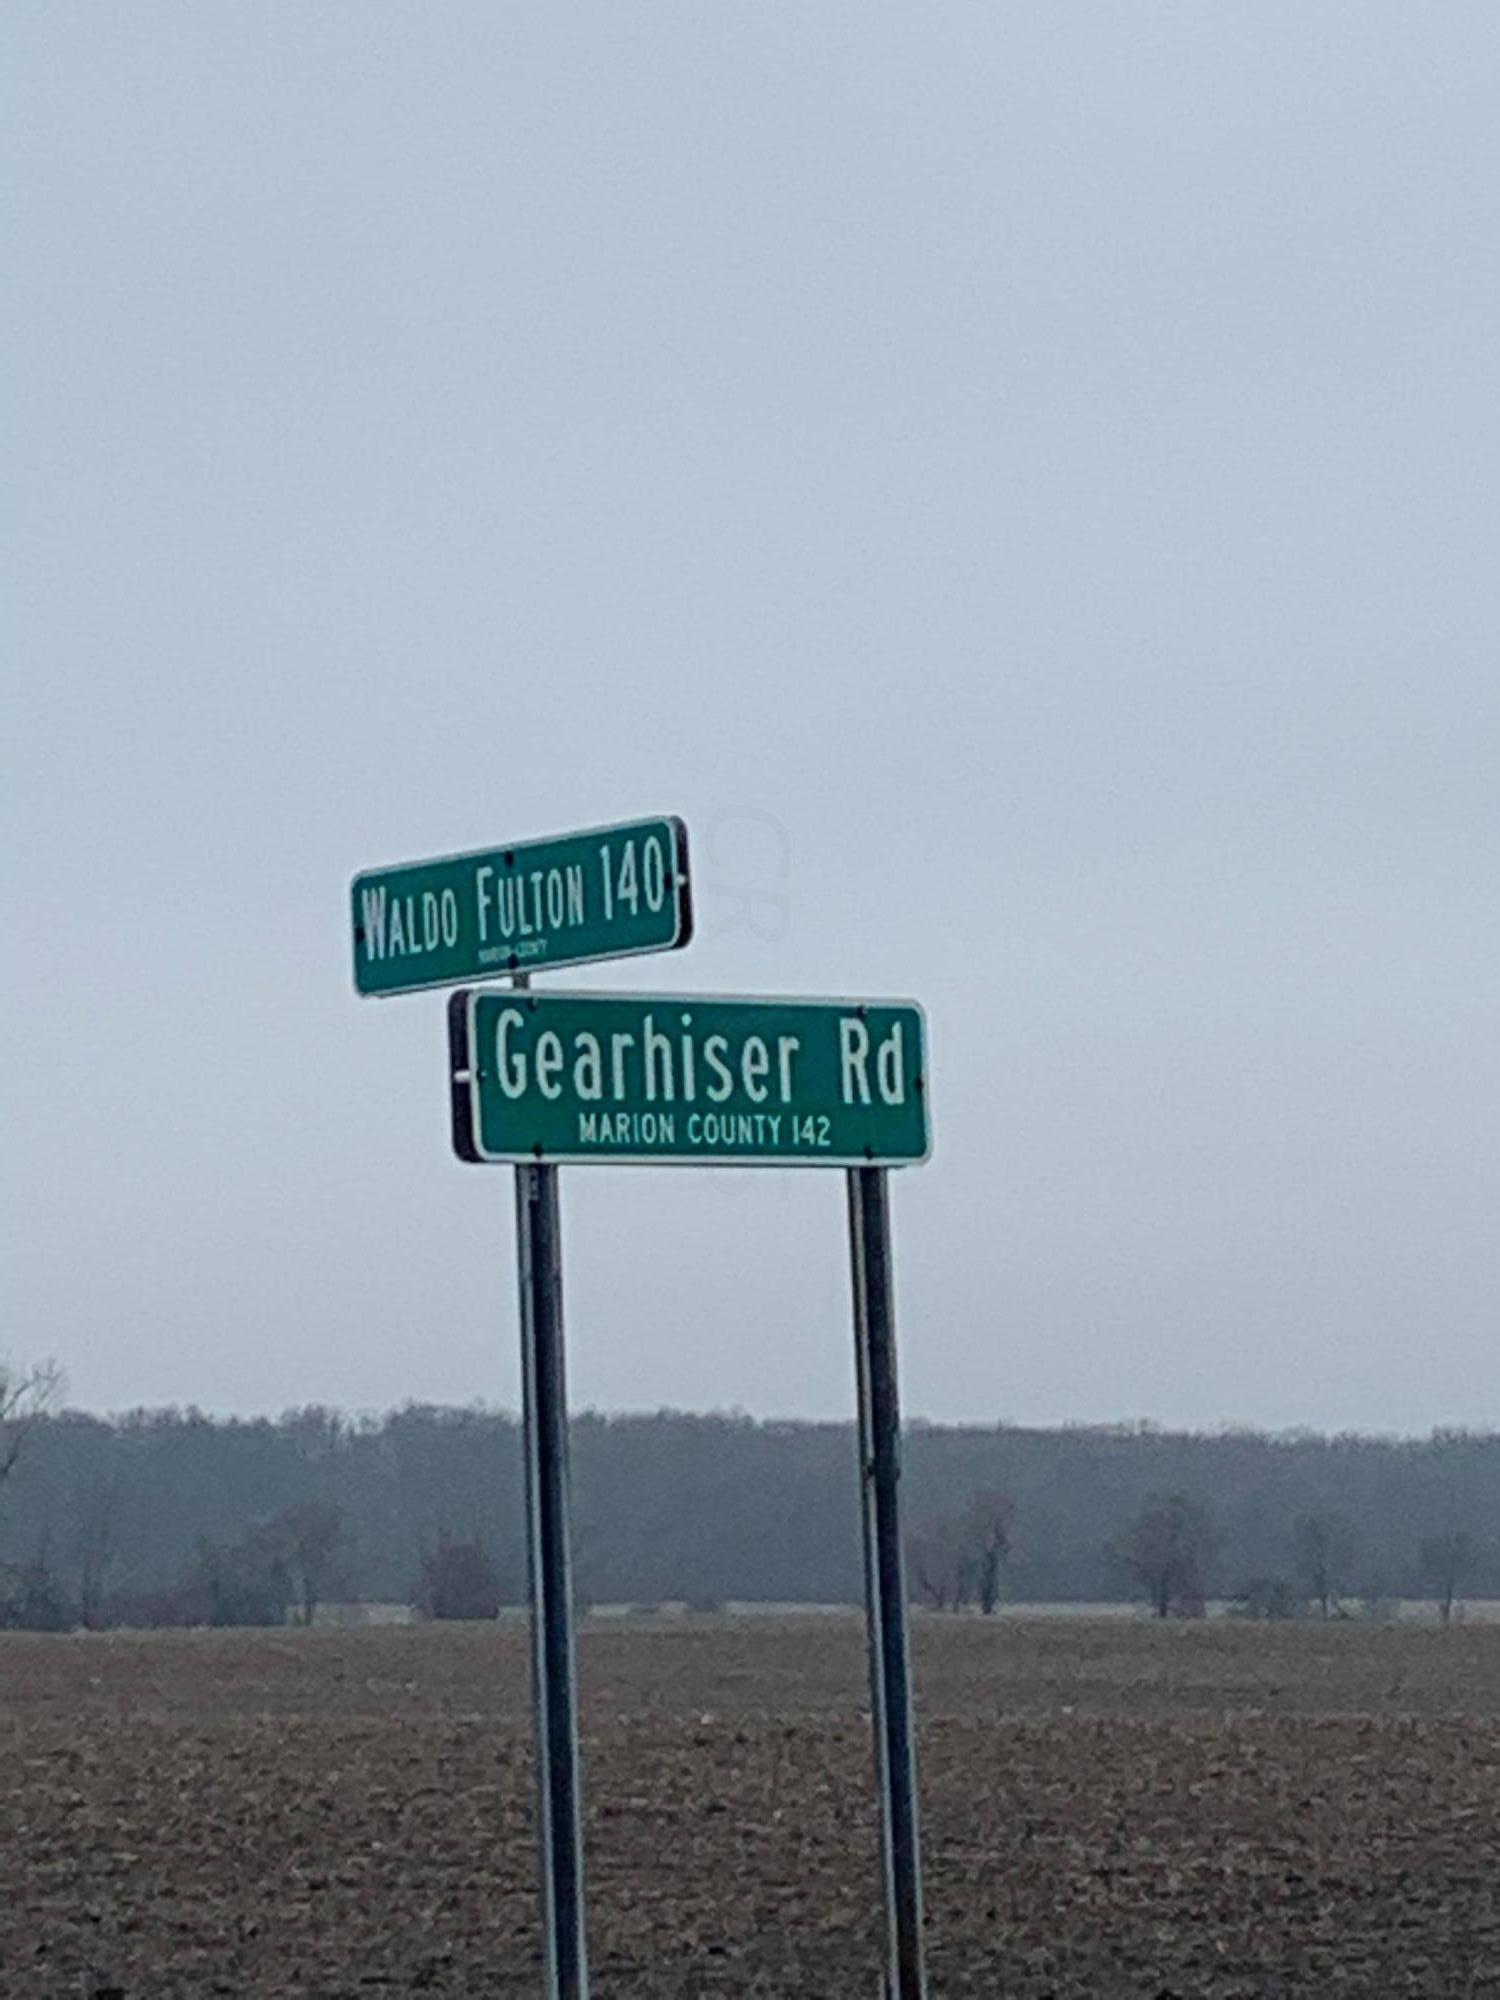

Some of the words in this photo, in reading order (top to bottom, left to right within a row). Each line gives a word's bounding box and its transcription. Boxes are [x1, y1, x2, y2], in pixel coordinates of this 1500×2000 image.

[362, 886, 458, 960] WALDO
[475, 866, 585, 940] FULTON
[599, 834, 664, 920] 140
[495, 1008, 800, 1104] Gearhiser
[839, 1018, 906, 1105] Rd
[579, 1113, 675, 1144] MARION
[687, 1116, 781, 1146] COUNTY
[791, 1115, 830, 1148] 142
